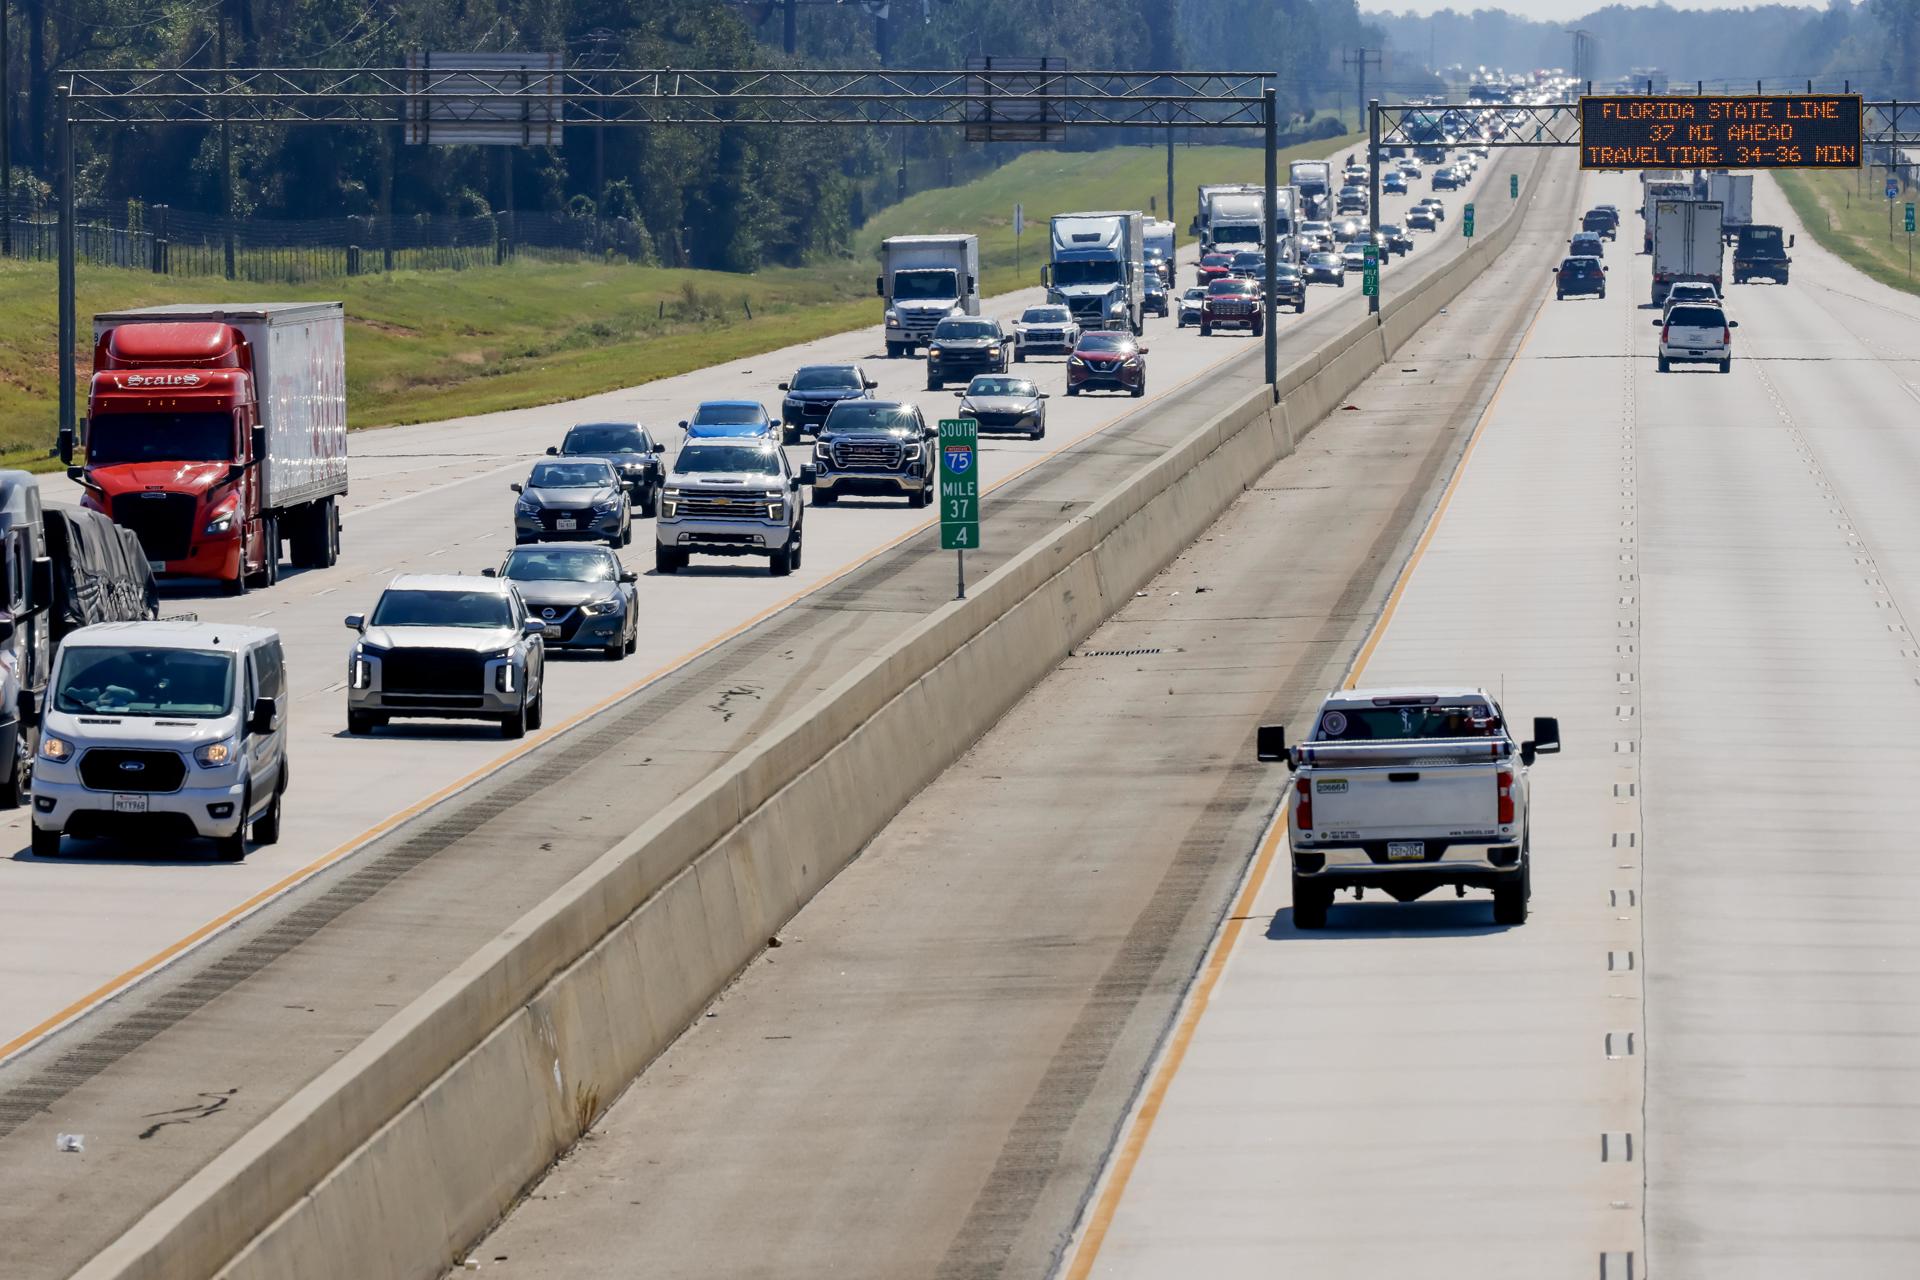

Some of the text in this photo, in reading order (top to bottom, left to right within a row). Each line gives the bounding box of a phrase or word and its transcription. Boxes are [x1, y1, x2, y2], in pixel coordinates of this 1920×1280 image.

[1602, 101, 1839, 119] FLORIDA STATE LINE
[1649, 124, 1793, 142] 37 MI AHEAD
[1737, 145, 1802, 163] 34-36
[1815, 145, 1855, 162] MIN
[1367, 258, 1375, 266] 75
[940, 422, 975, 437] SOUTH
[948, 453, 969, 469] 75
[943, 482, 975, 497] MILE
[950, 499, 969, 518] 37
[952, 526, 968, 545] .4
